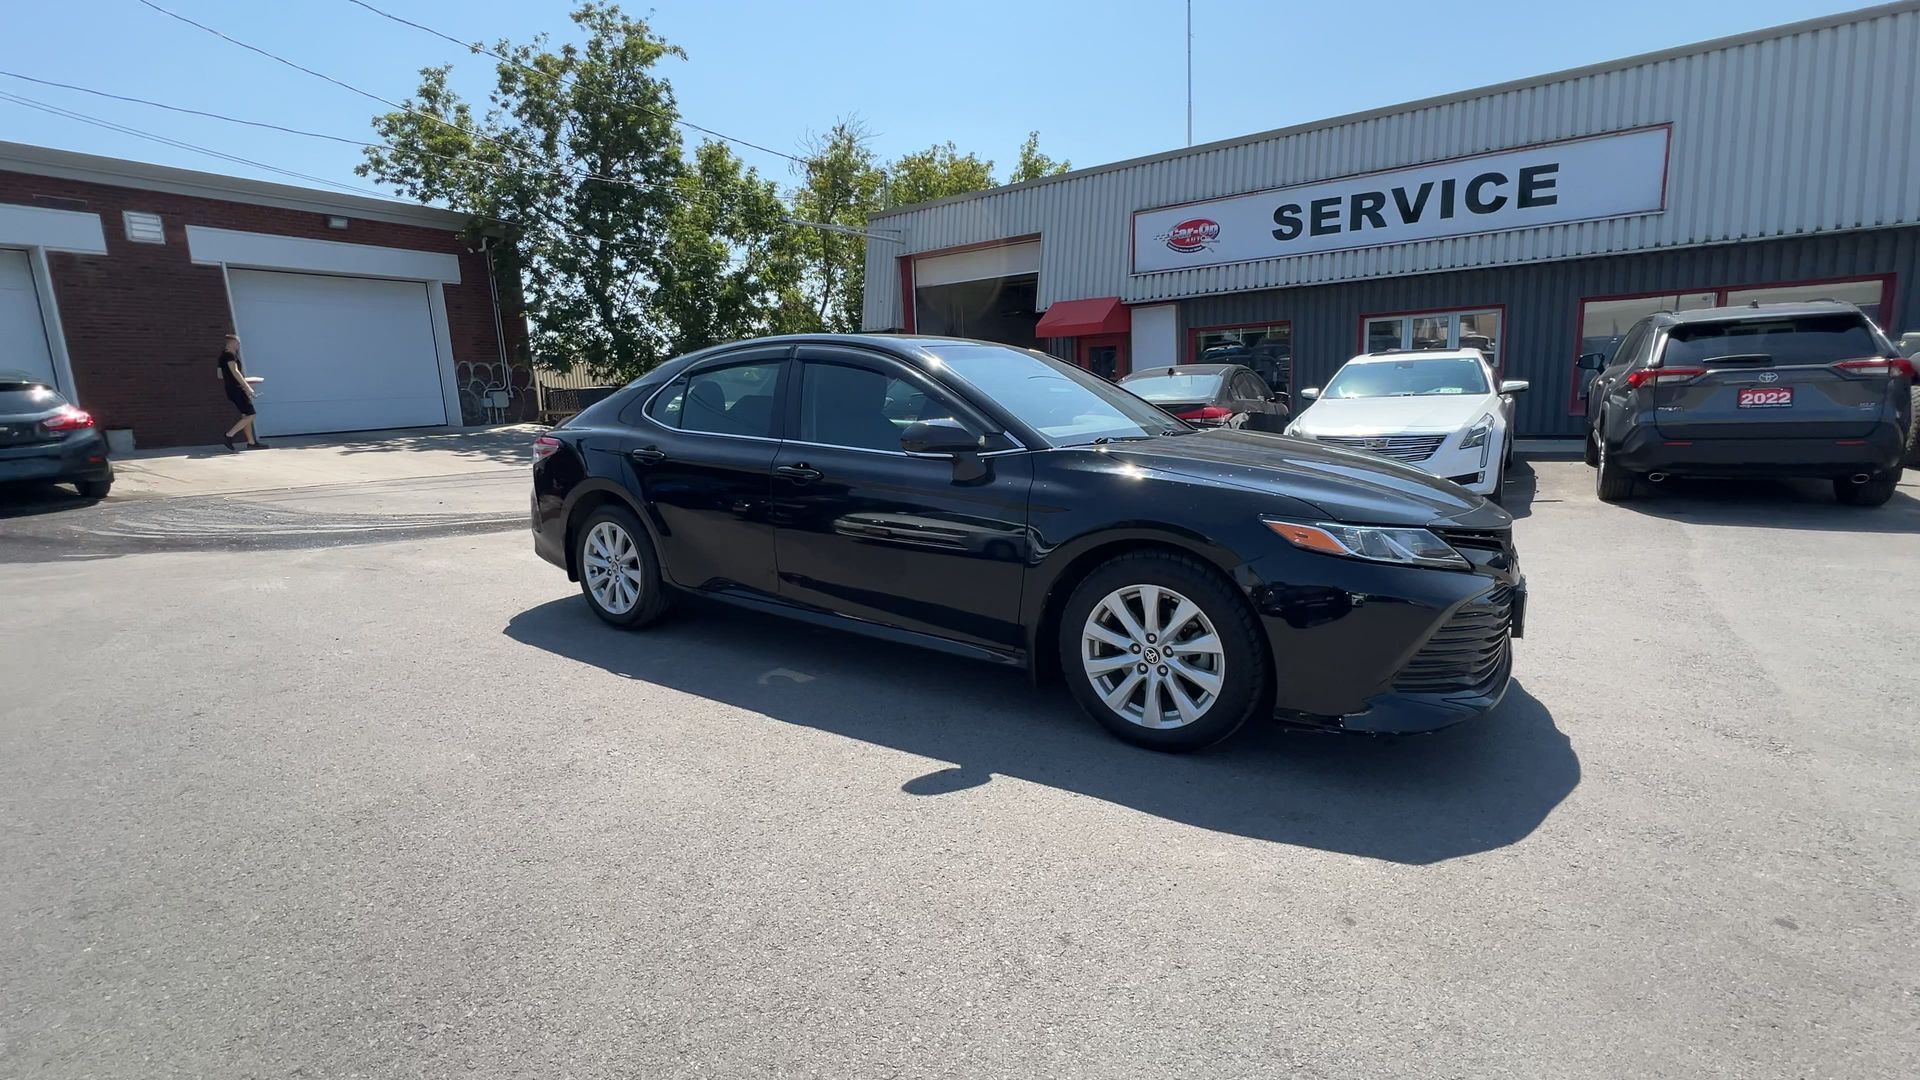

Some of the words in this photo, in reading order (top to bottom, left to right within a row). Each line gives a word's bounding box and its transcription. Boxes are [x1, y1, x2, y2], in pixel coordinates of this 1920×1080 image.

[1272, 163, 1559, 240] SERVICE
[1168, 223, 1219, 240] Car-On
[1741, 392, 1791, 405] 2022
